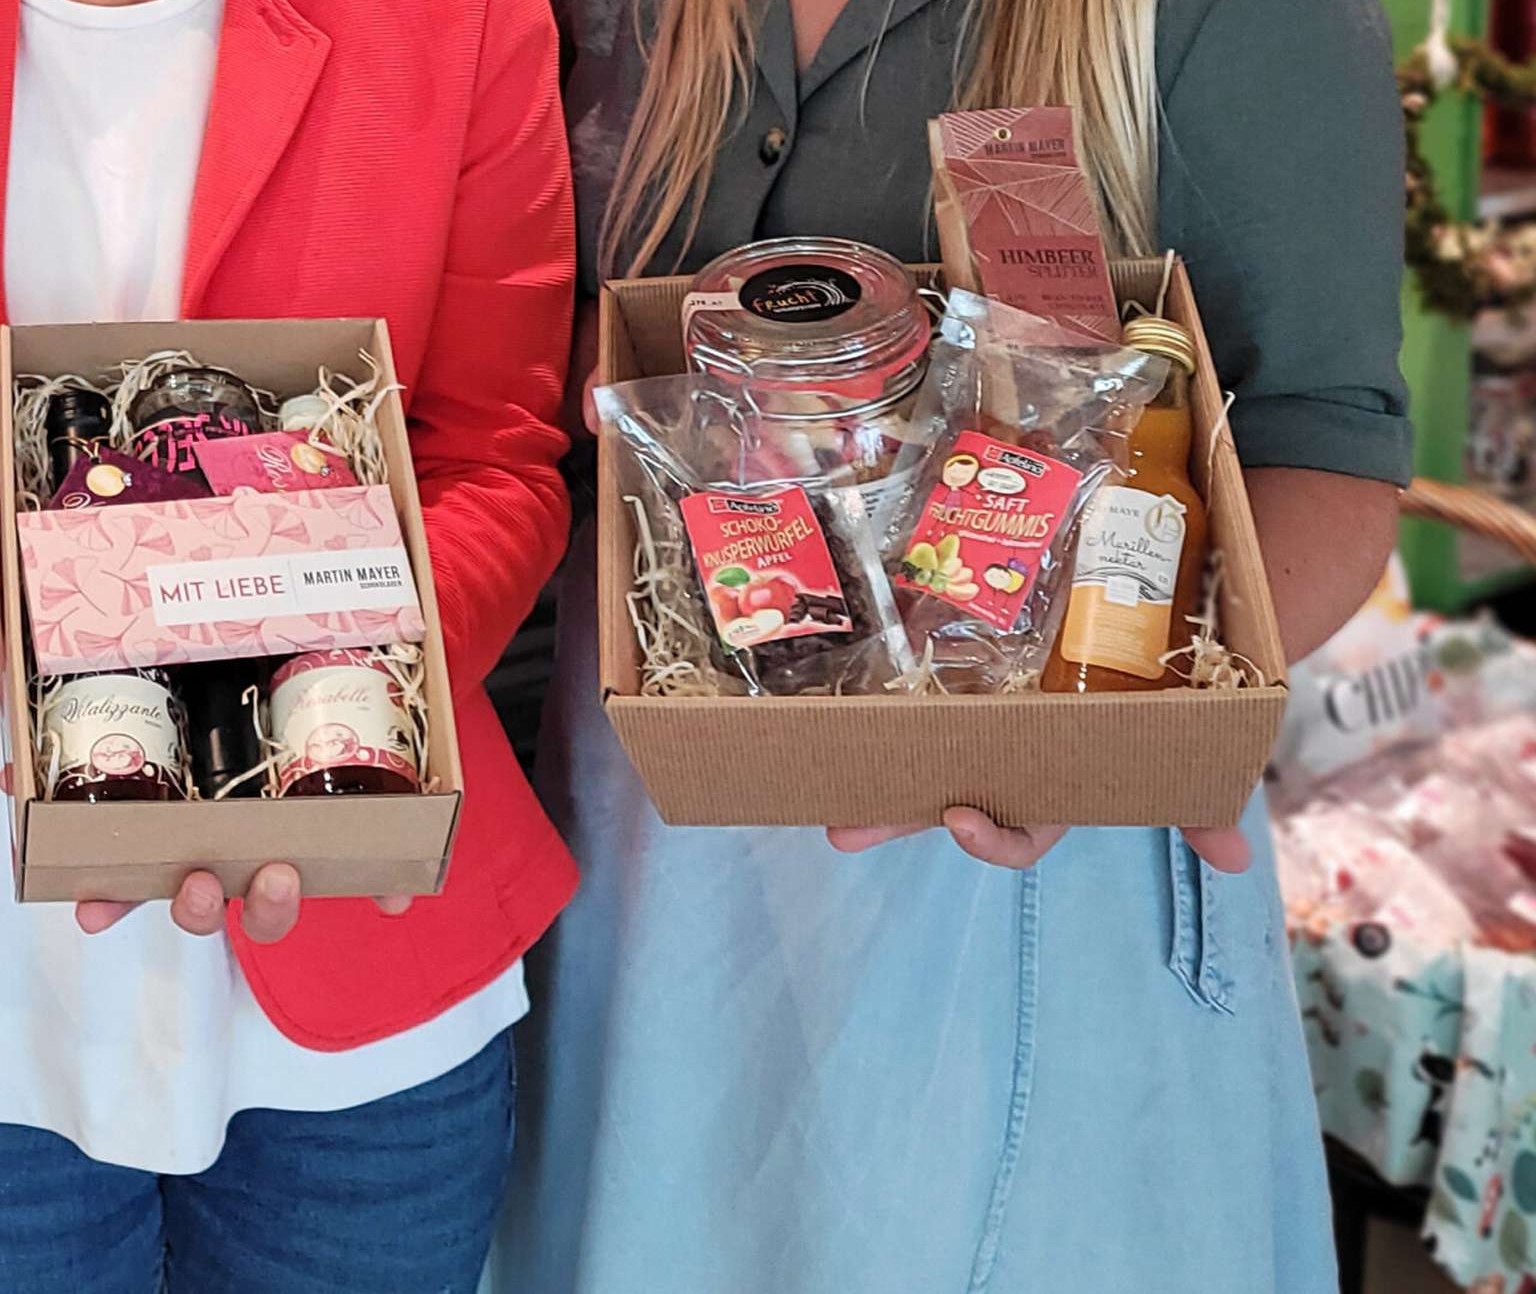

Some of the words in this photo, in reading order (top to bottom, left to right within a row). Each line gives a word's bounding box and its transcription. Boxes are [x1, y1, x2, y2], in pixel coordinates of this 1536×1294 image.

[999, 248, 1096, 265] HIMBEER
[1028, 265, 1096, 279] SPLITTER
[982, 493, 1030, 512] SAFT
[720, 516, 783, 538] SCHOKO-
[756, 552, 793, 569] APFEL
[303, 568, 353, 586] MARTIN
[356, 565, 401, 582] MAYER
[159, 581, 205, 604] MIT
[215, 574, 286, 600] LIEBE
